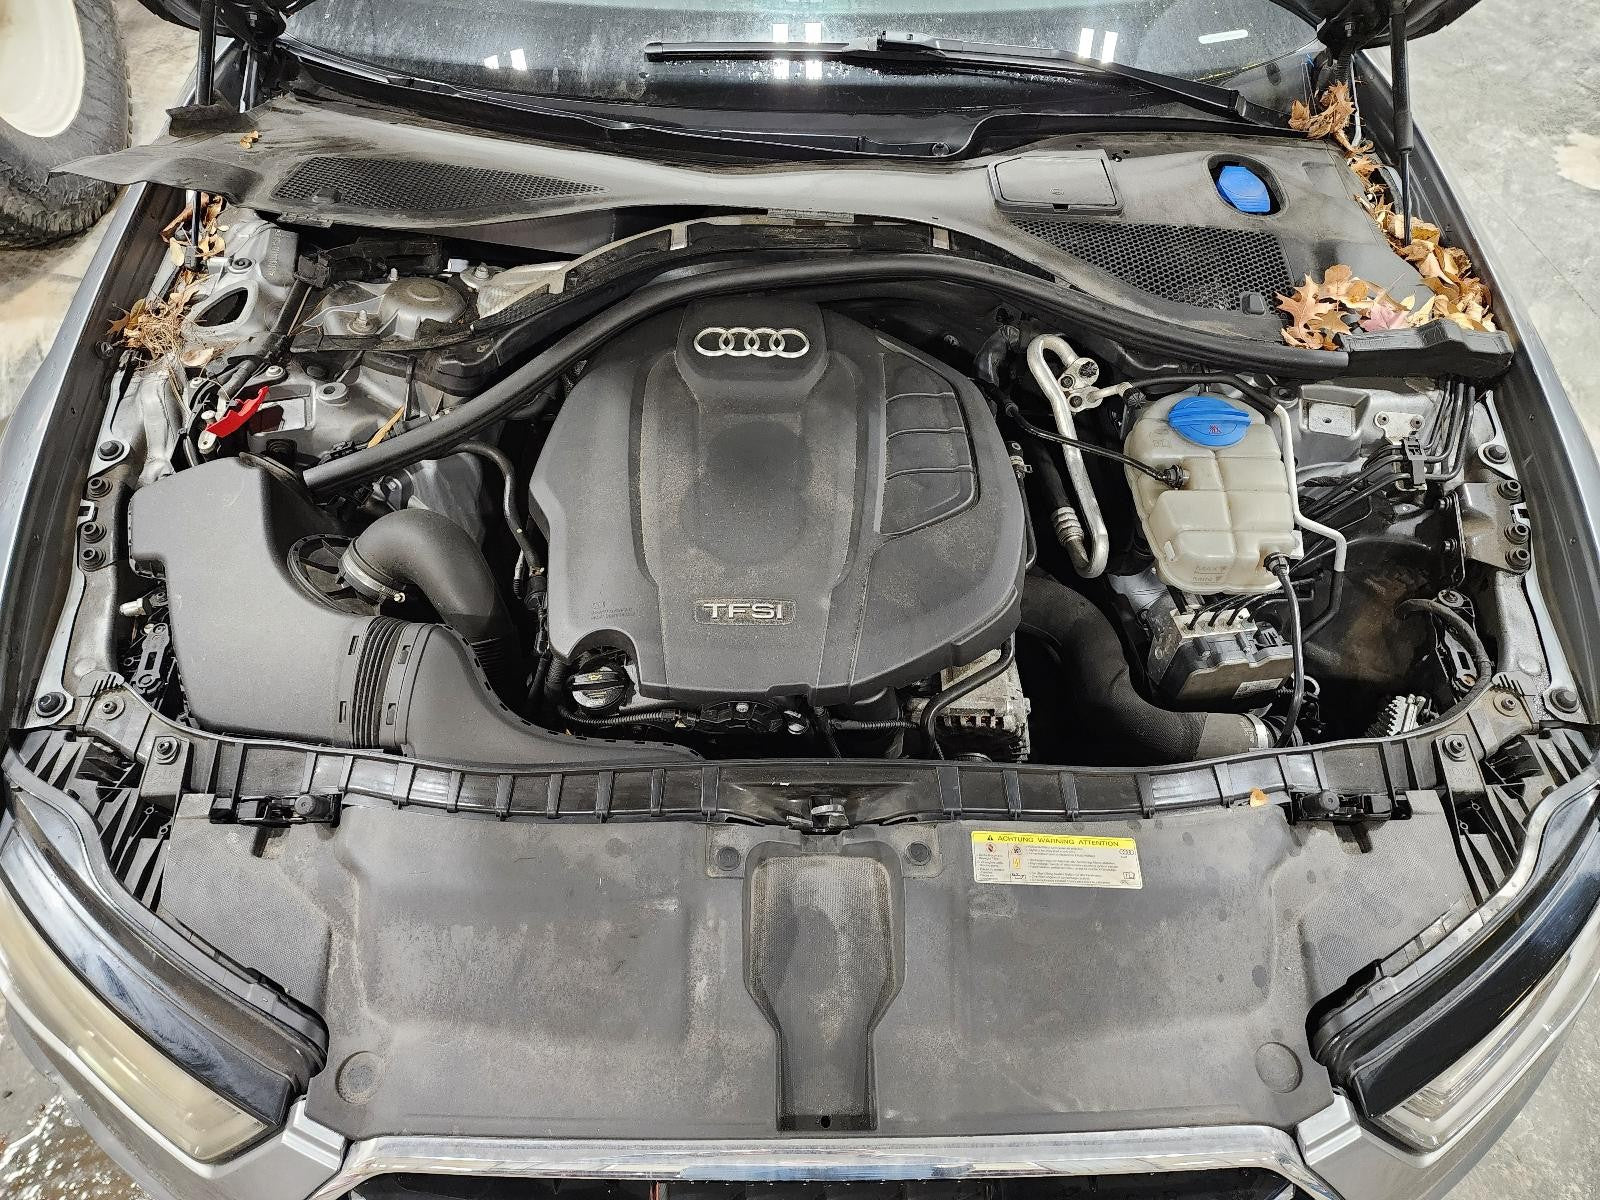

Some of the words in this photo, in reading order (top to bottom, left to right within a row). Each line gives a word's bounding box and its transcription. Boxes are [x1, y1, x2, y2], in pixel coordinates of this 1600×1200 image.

[703, 602, 783, 619] TFSI
[997, 835, 1034, 843] ACHTUNG
[1037, 837, 1075, 845] WARNING
[1078, 839, 1119, 847] ATTENTION
